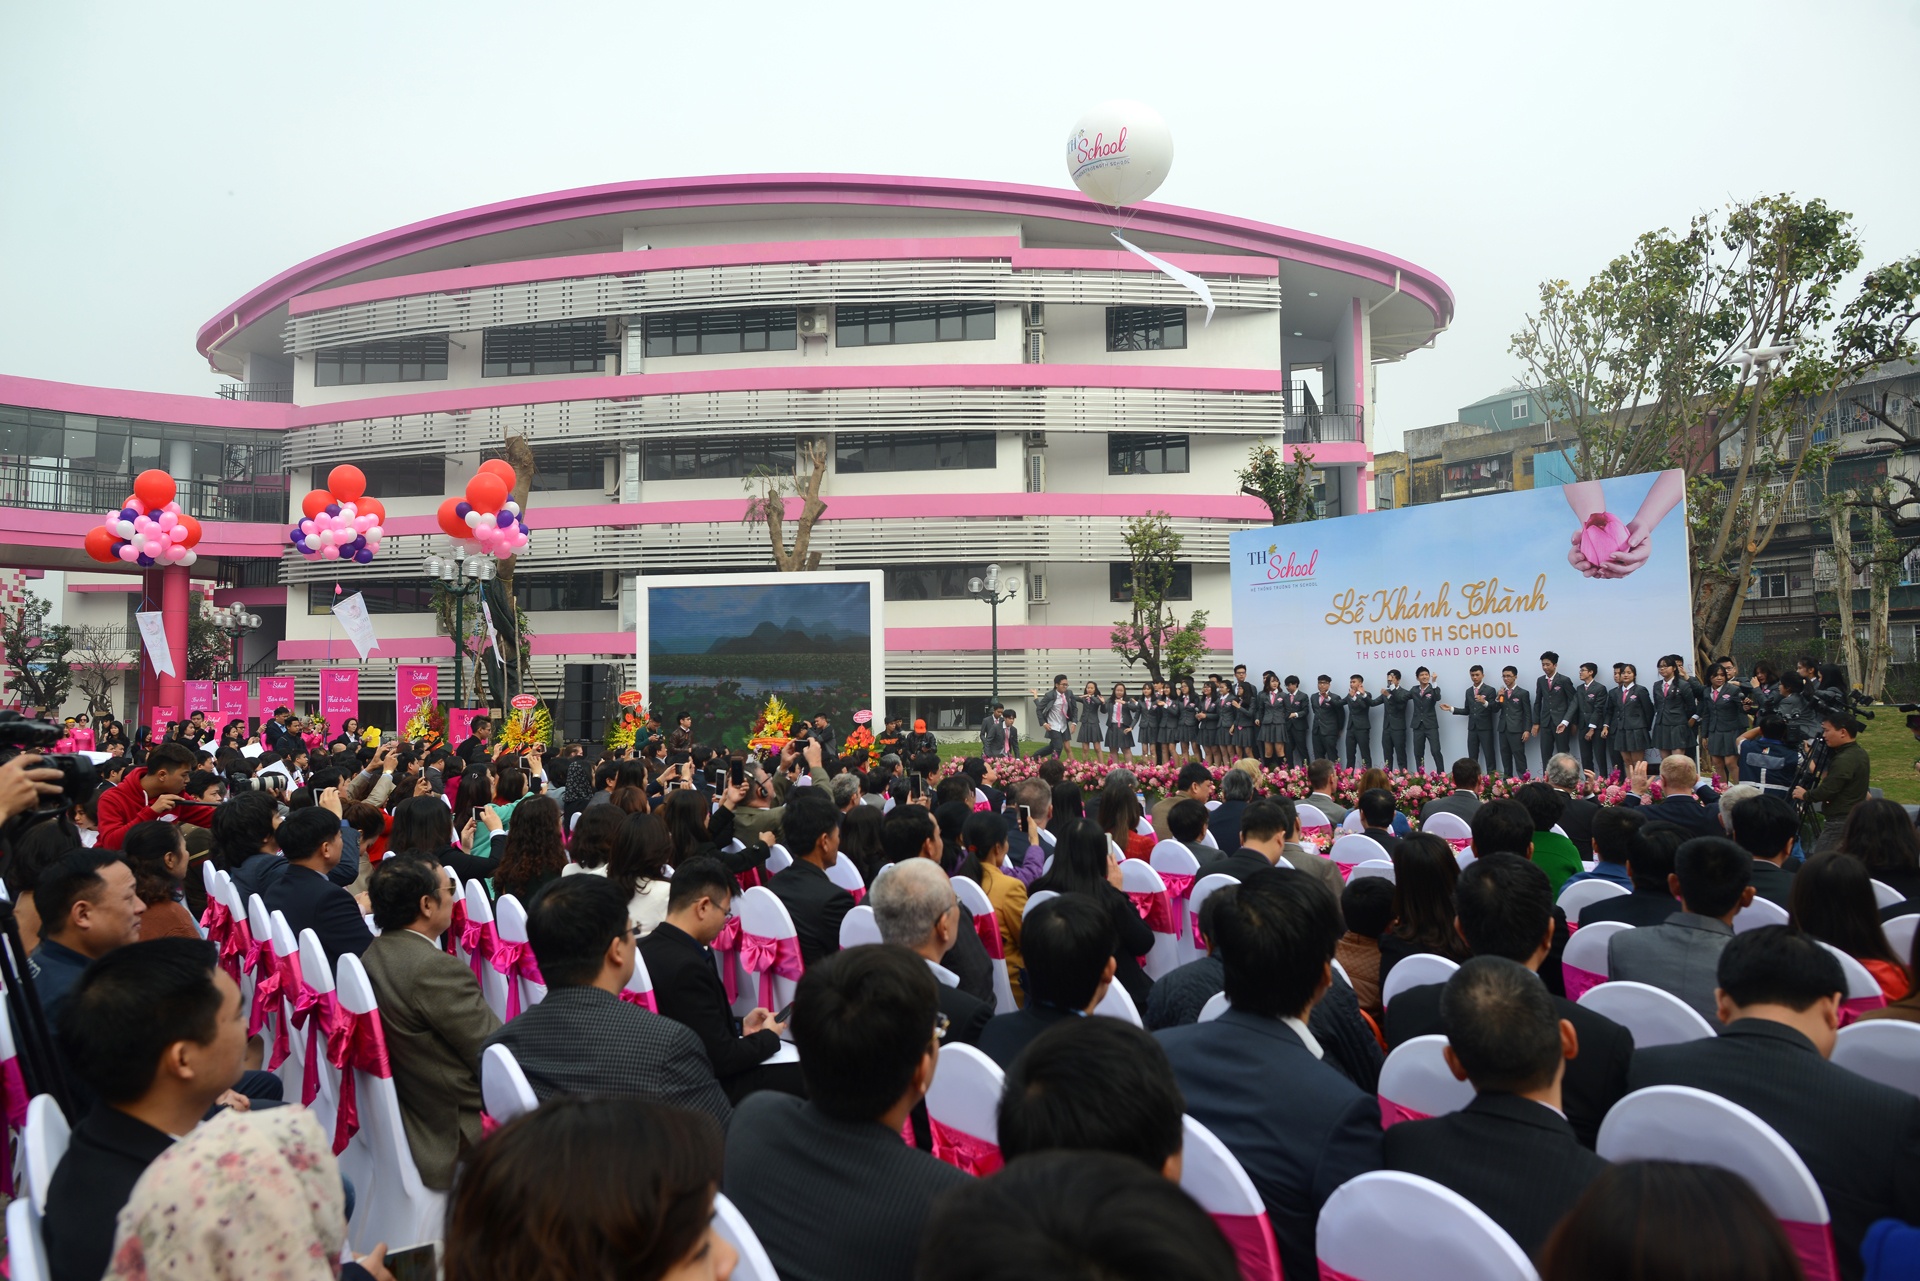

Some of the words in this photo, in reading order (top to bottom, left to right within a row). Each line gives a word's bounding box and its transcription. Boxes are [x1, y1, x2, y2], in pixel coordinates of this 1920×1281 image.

[1066, 136, 1076, 154] TH
[1077, 126, 1127, 164] School
[1247, 550, 1267, 566] TH
[1267, 549, 1319, 580] School
[1325, 588, 1369, 625] Lễ
[1369, 581, 1452, 623] Khánh
[1456, 573, 1549, 620] Thành
[1353, 625, 1417, 645] TRƯỜNG
[1421, 625, 1443, 642] TH
[1448, 621, 1518, 641] SCHOOL
[1356, 651, 1369, 660] TH
[1373, 649, 1416, 660] SCHOOL
[1421, 647, 1460, 657] GRAND
[1465, 644, 1520, 656] OPENING
[272, 681, 288, 689] School
[334, 673, 351, 682] School
[412, 672, 430, 681] School
